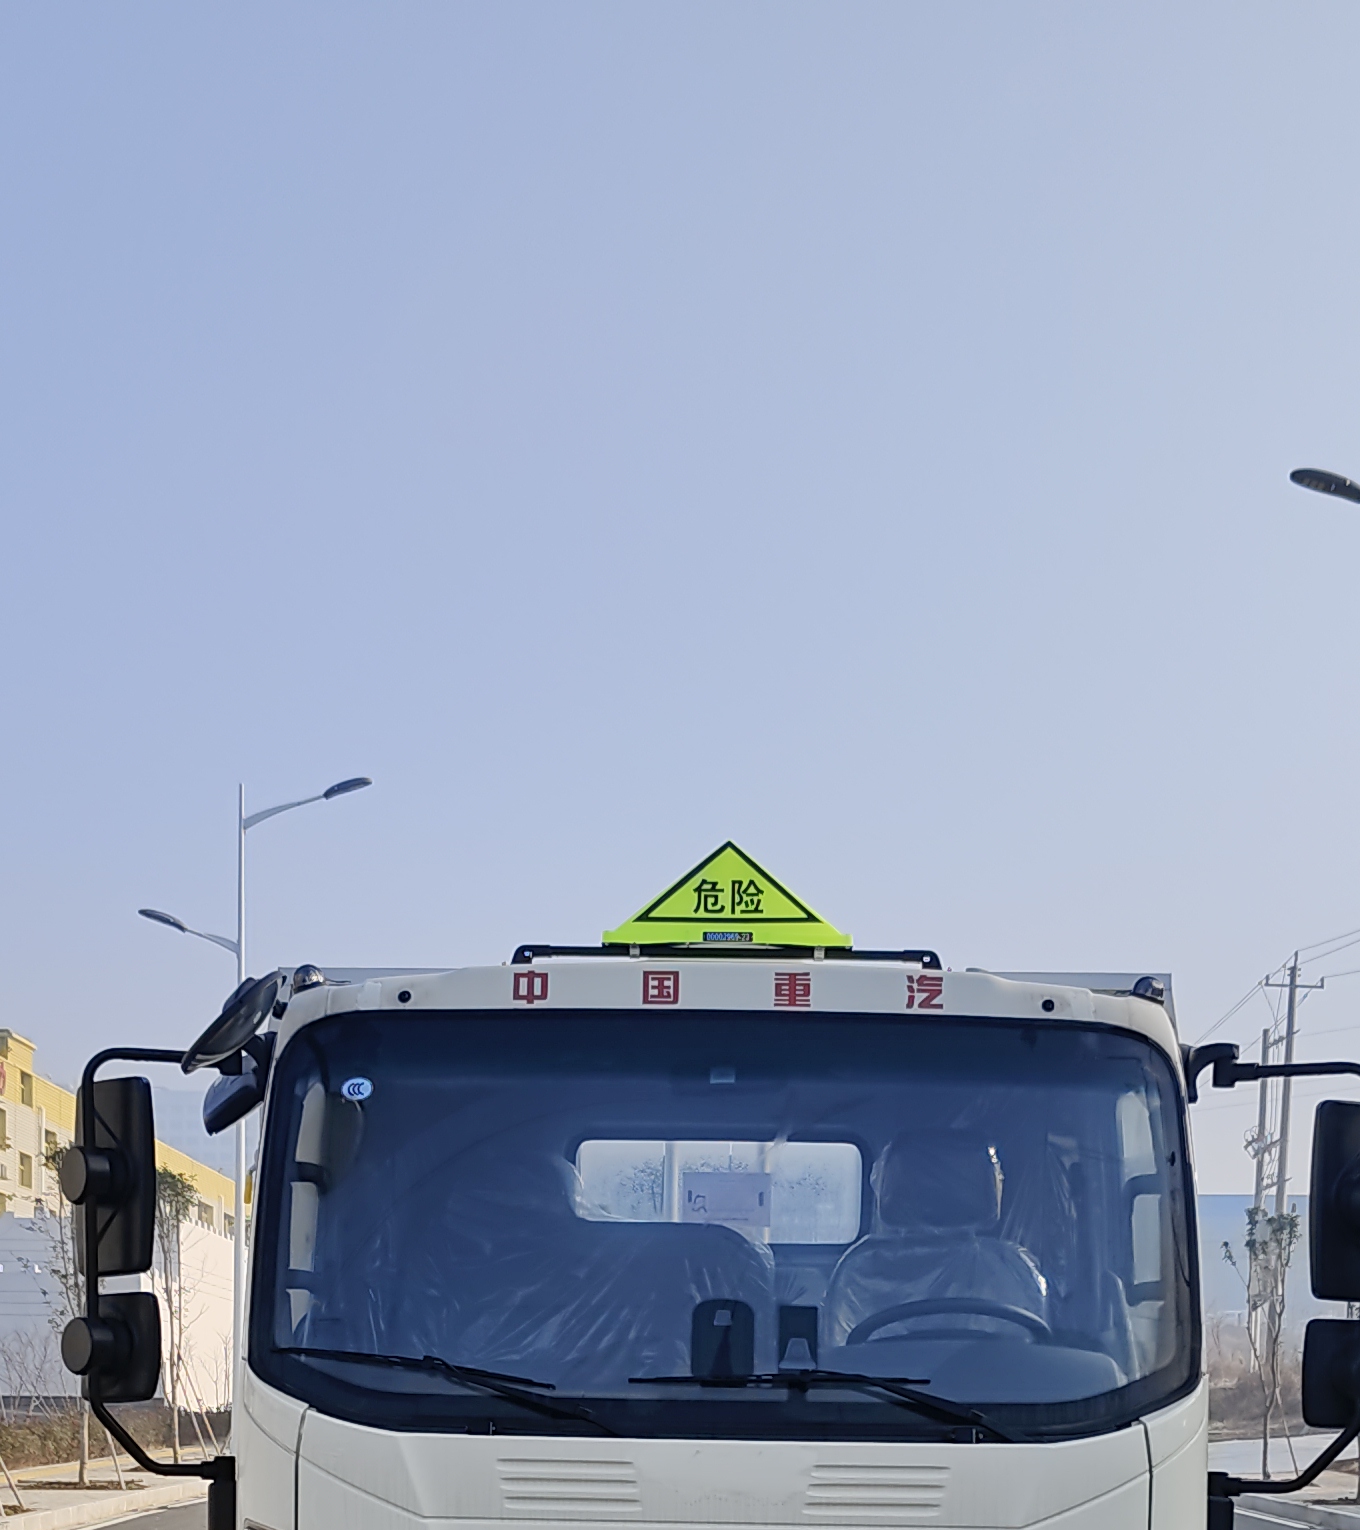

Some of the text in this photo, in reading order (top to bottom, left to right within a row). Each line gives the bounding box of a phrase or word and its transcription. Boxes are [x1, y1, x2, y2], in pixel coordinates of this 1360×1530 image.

[692, 878, 765, 915] 危险
[512, 969, 944, 1010] 中国重汽
